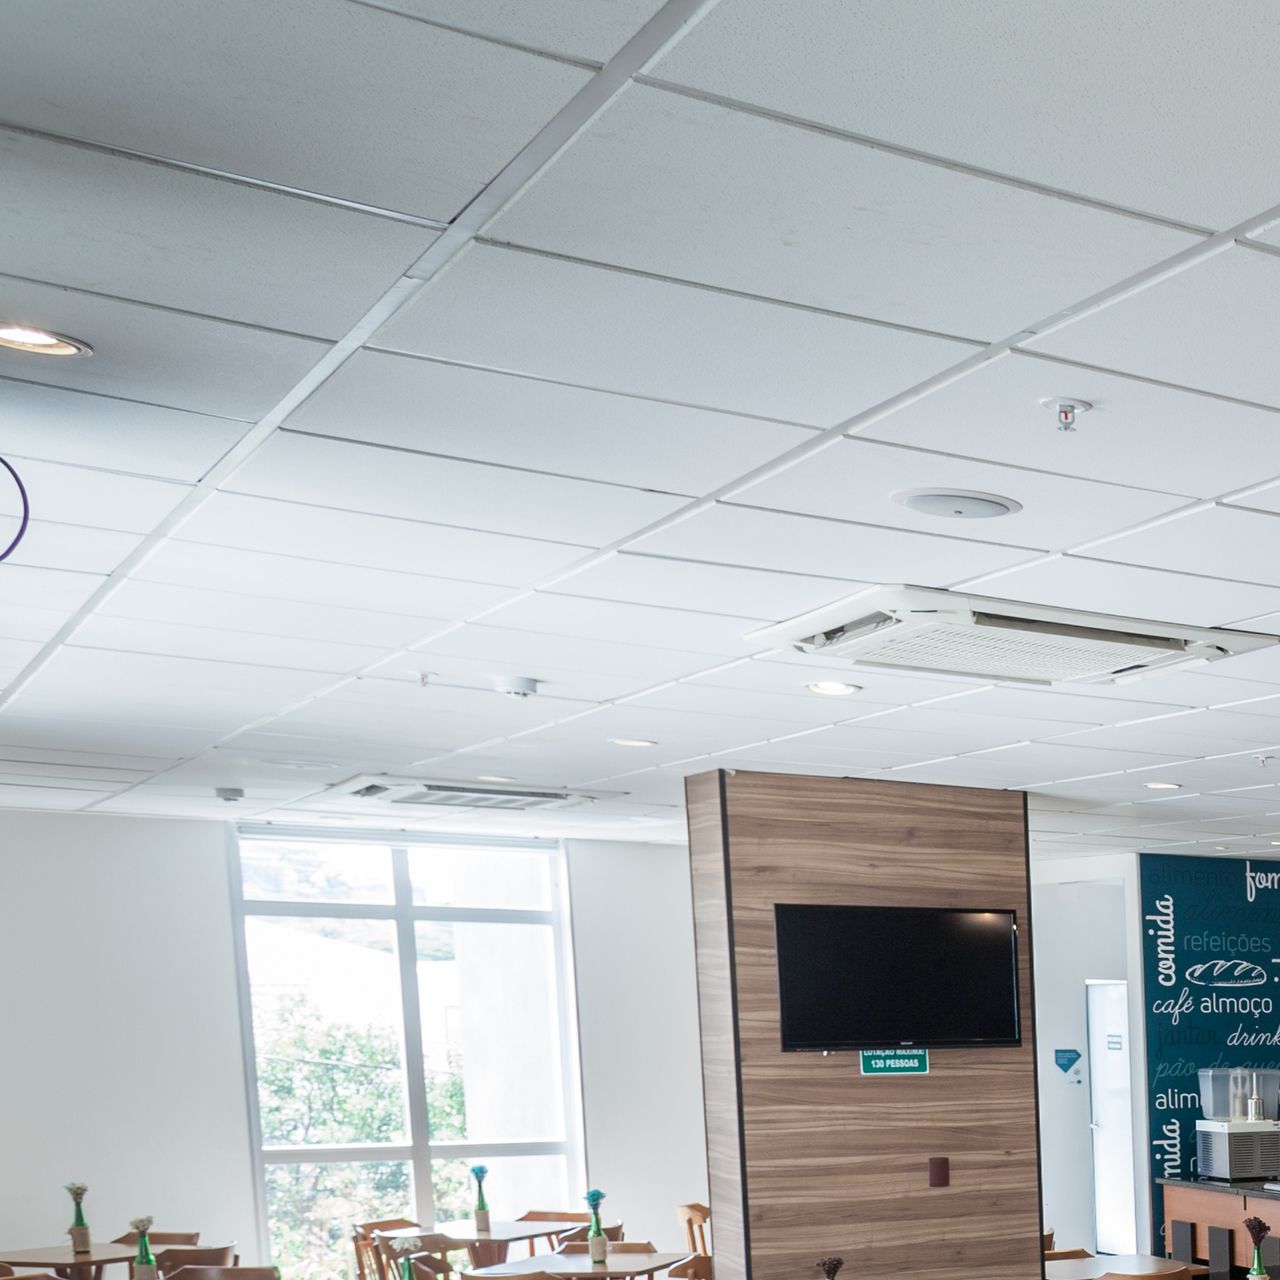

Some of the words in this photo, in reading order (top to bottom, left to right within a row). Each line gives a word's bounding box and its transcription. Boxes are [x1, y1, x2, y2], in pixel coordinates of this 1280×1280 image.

[1145, 894, 1177, 987] comida
[1183, 930, 1272, 957] refeições
[1152, 986, 1195, 1025] café
[1200, 992, 1273, 1018] almoço
[871, 1059, 885, 1068] 130
[886, 1059, 919, 1068] PESSOAS
[1152, 1057, 1199, 1088] pão
[1155, 1088, 1200, 1110] alim
